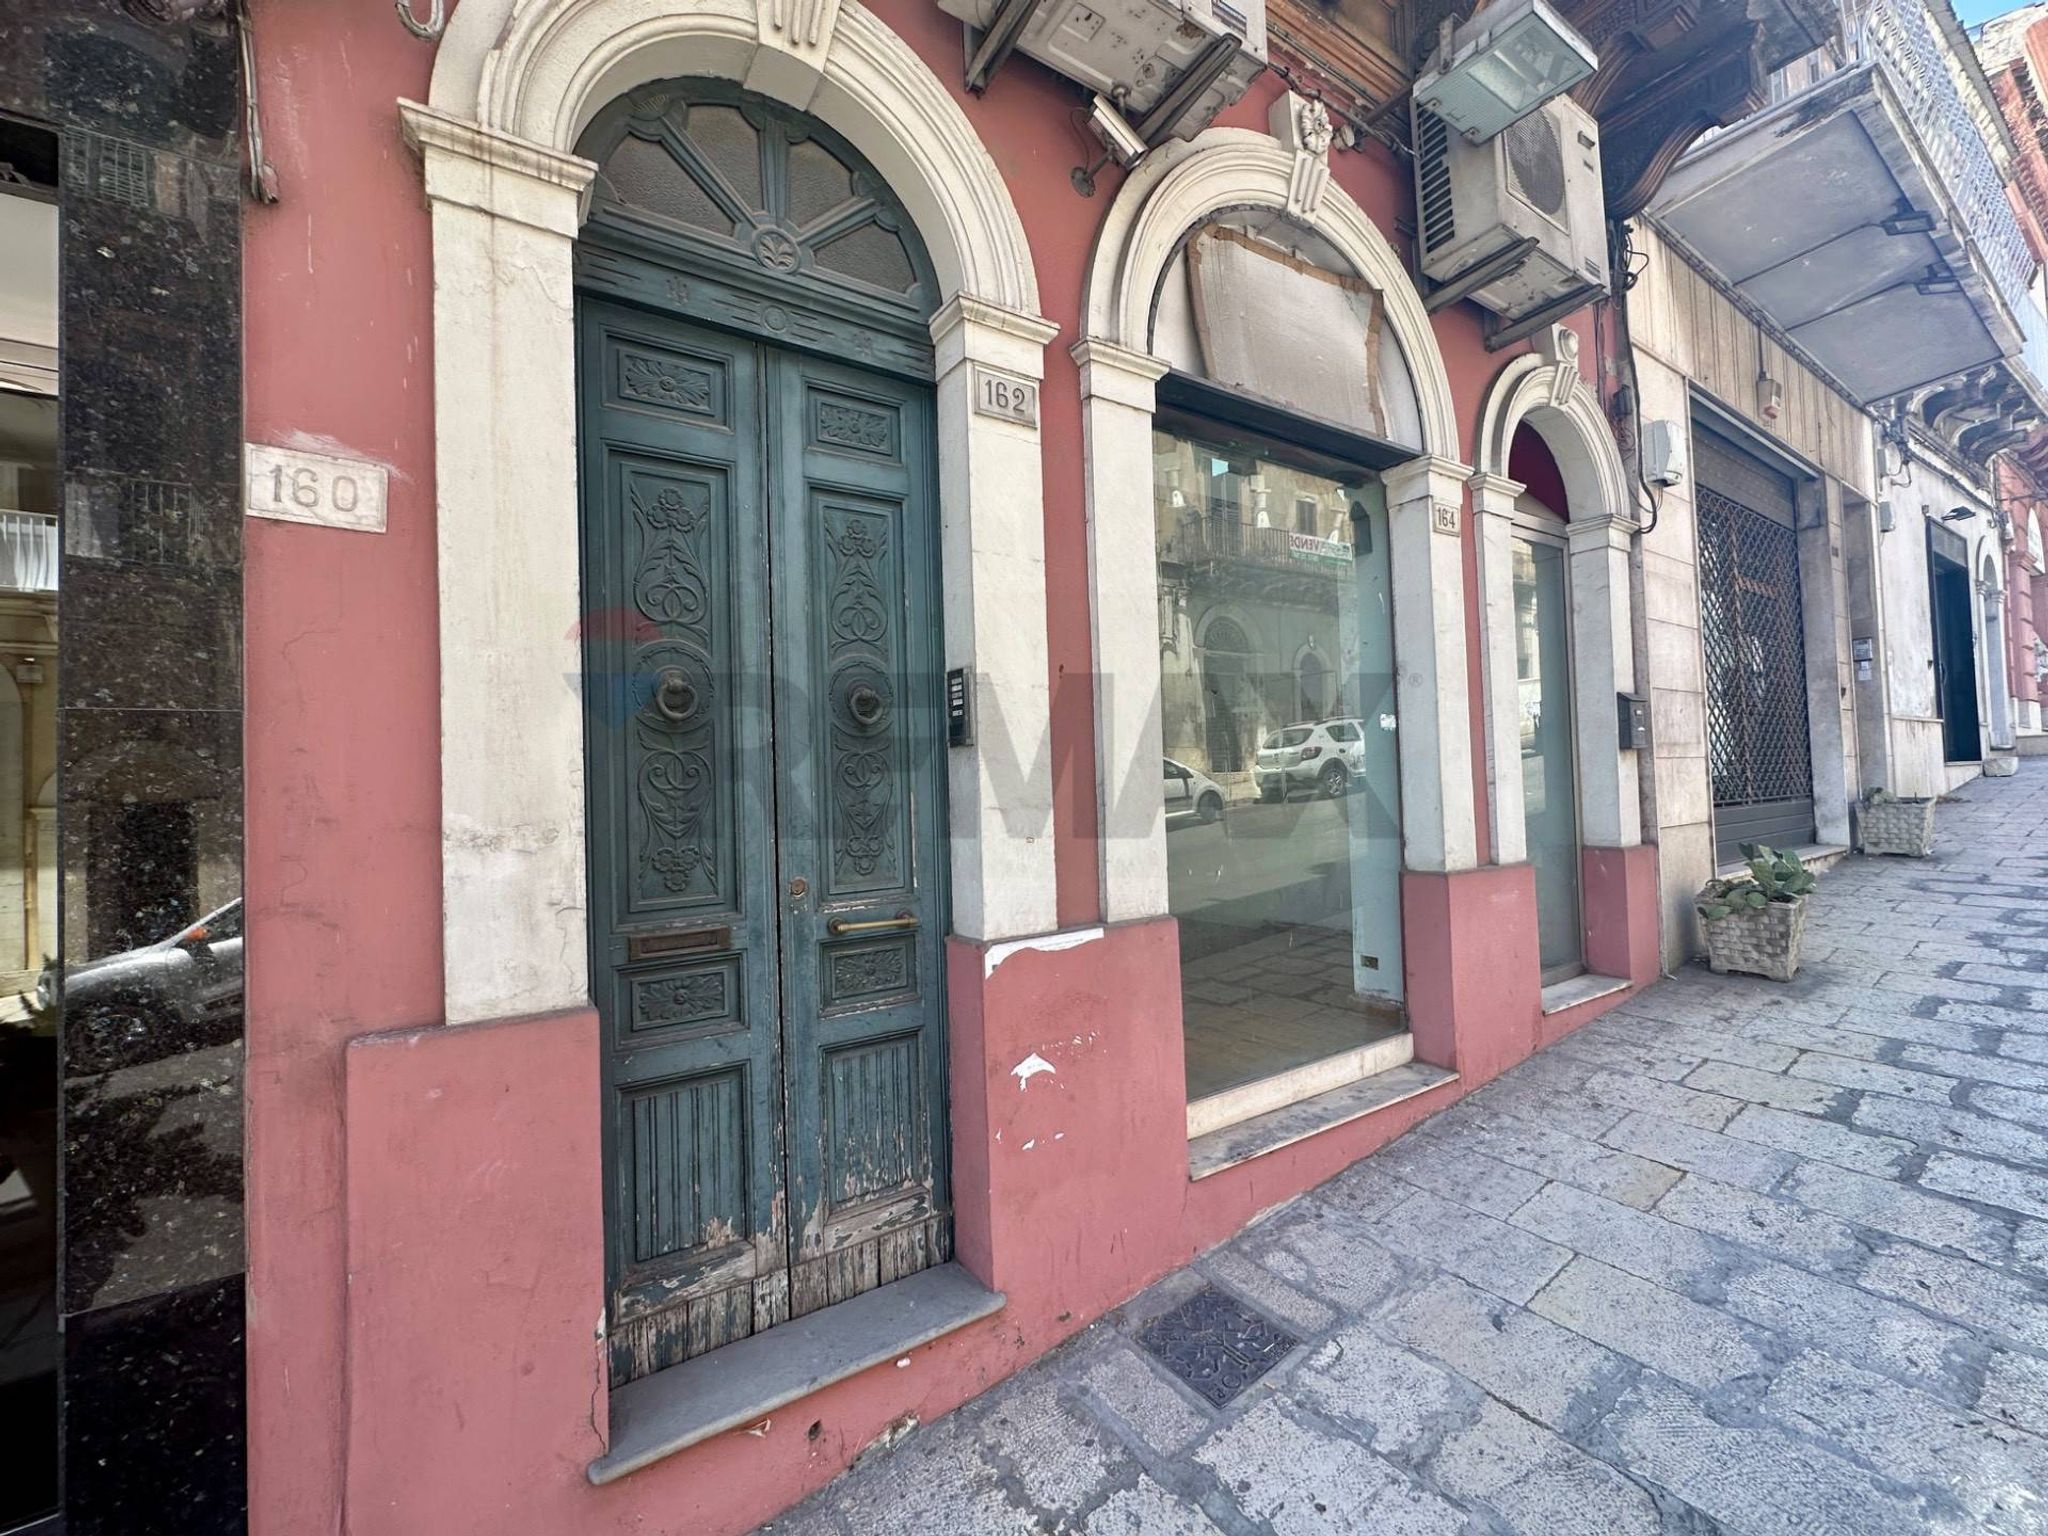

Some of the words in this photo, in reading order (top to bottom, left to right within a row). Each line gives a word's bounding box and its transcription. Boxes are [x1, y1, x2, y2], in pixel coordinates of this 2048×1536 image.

[985, 380, 1026, 414] 162
[269, 464, 359, 513] 160
[1437, 506, 1456, 529] 164
